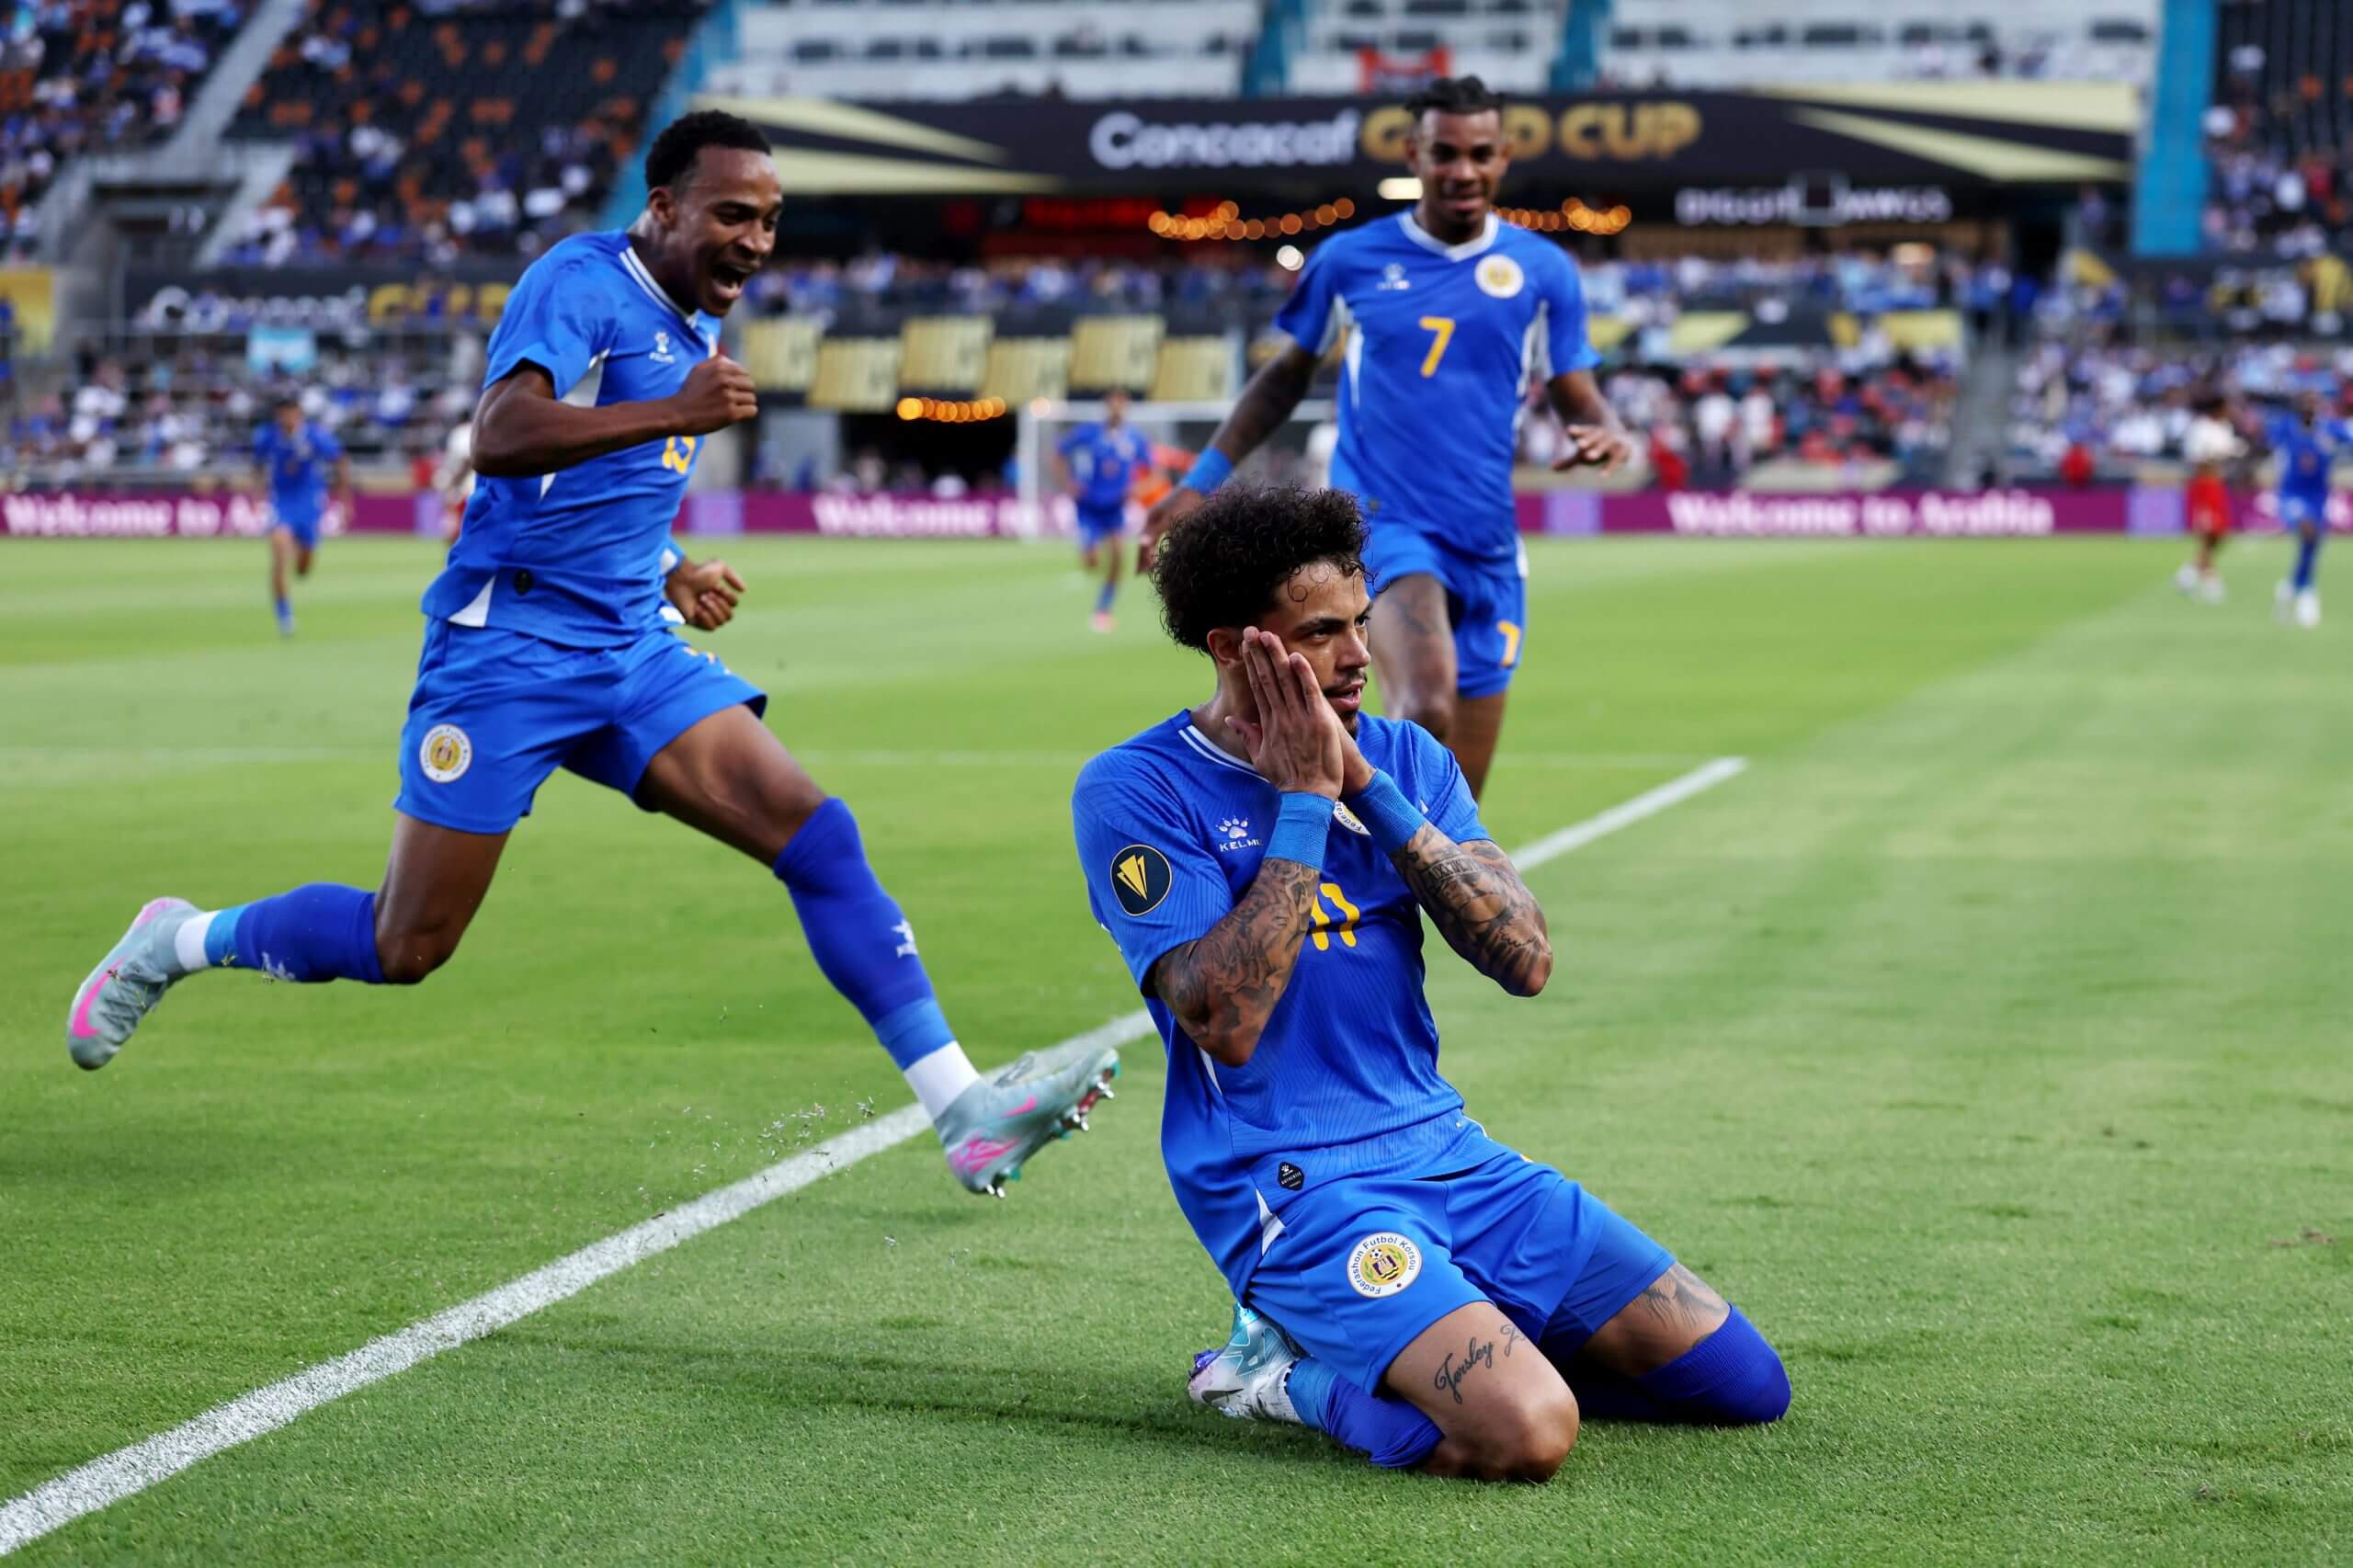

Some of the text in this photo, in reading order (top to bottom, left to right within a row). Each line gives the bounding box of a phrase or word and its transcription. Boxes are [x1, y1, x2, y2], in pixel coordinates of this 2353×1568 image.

[1089, 108, 1360, 169] Concacaf
[1559, 101, 1702, 161] CUP
[1419, 315, 1456, 379] 7
[813, 493, 991, 536] Welcome
[1666, 490, 2055, 535] Welcome to Arabia
[1497, 619, 1520, 668] 7
[1350, 1250, 1381, 1295] Federashon
